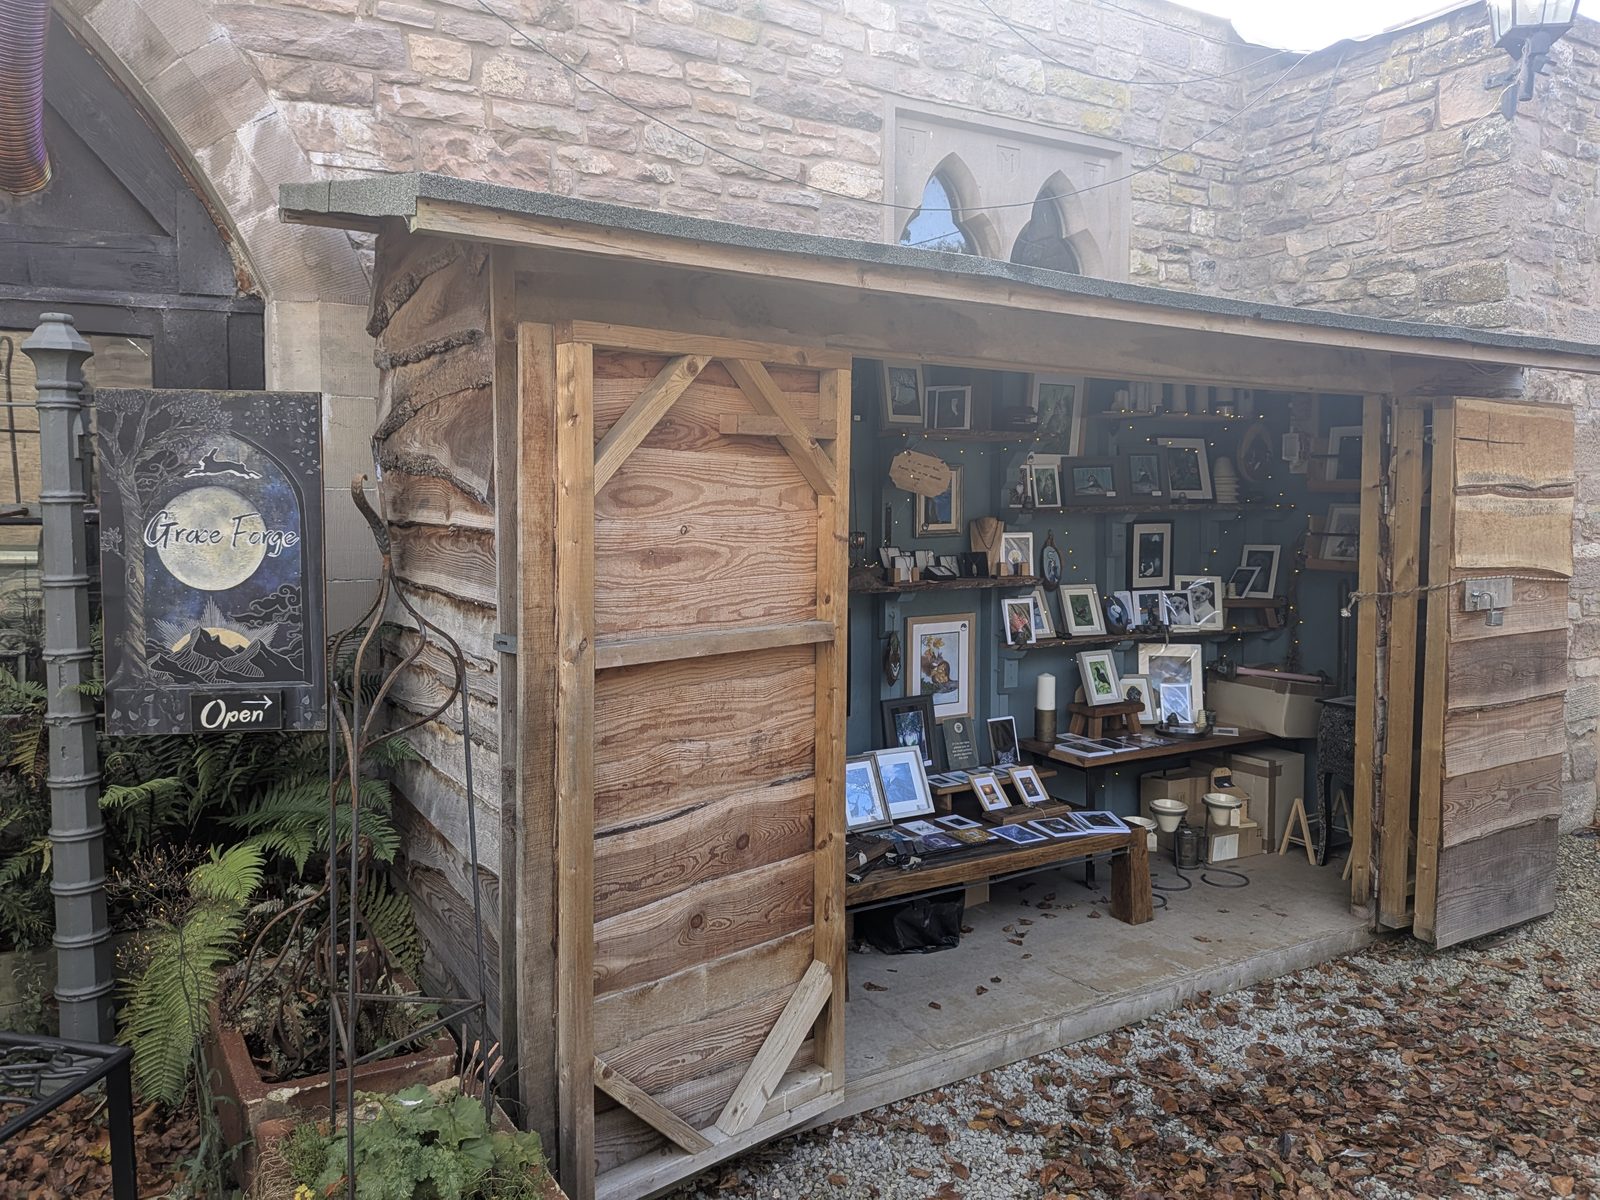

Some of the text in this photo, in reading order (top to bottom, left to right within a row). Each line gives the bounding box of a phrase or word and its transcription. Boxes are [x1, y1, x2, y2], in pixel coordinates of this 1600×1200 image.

[144, 509, 300, 557] Grace Forge
[200, 698, 264, 730] Open
